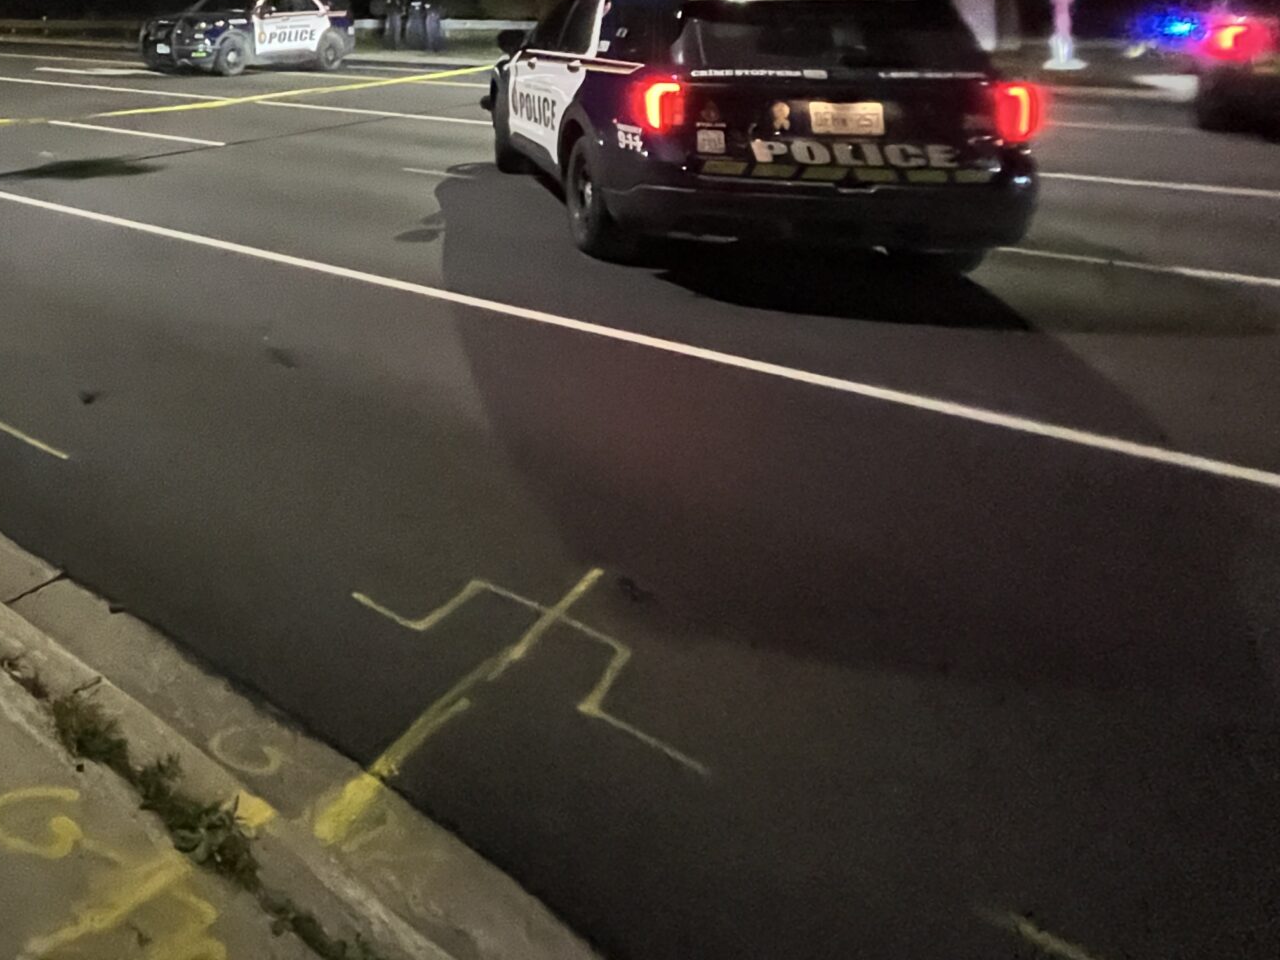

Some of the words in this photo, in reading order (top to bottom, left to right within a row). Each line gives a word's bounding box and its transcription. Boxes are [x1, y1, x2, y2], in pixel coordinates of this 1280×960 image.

[268, 29, 316, 44] POLICE
[519, 91, 556, 131] POLICE
[750, 139, 960, 168] POLICE
